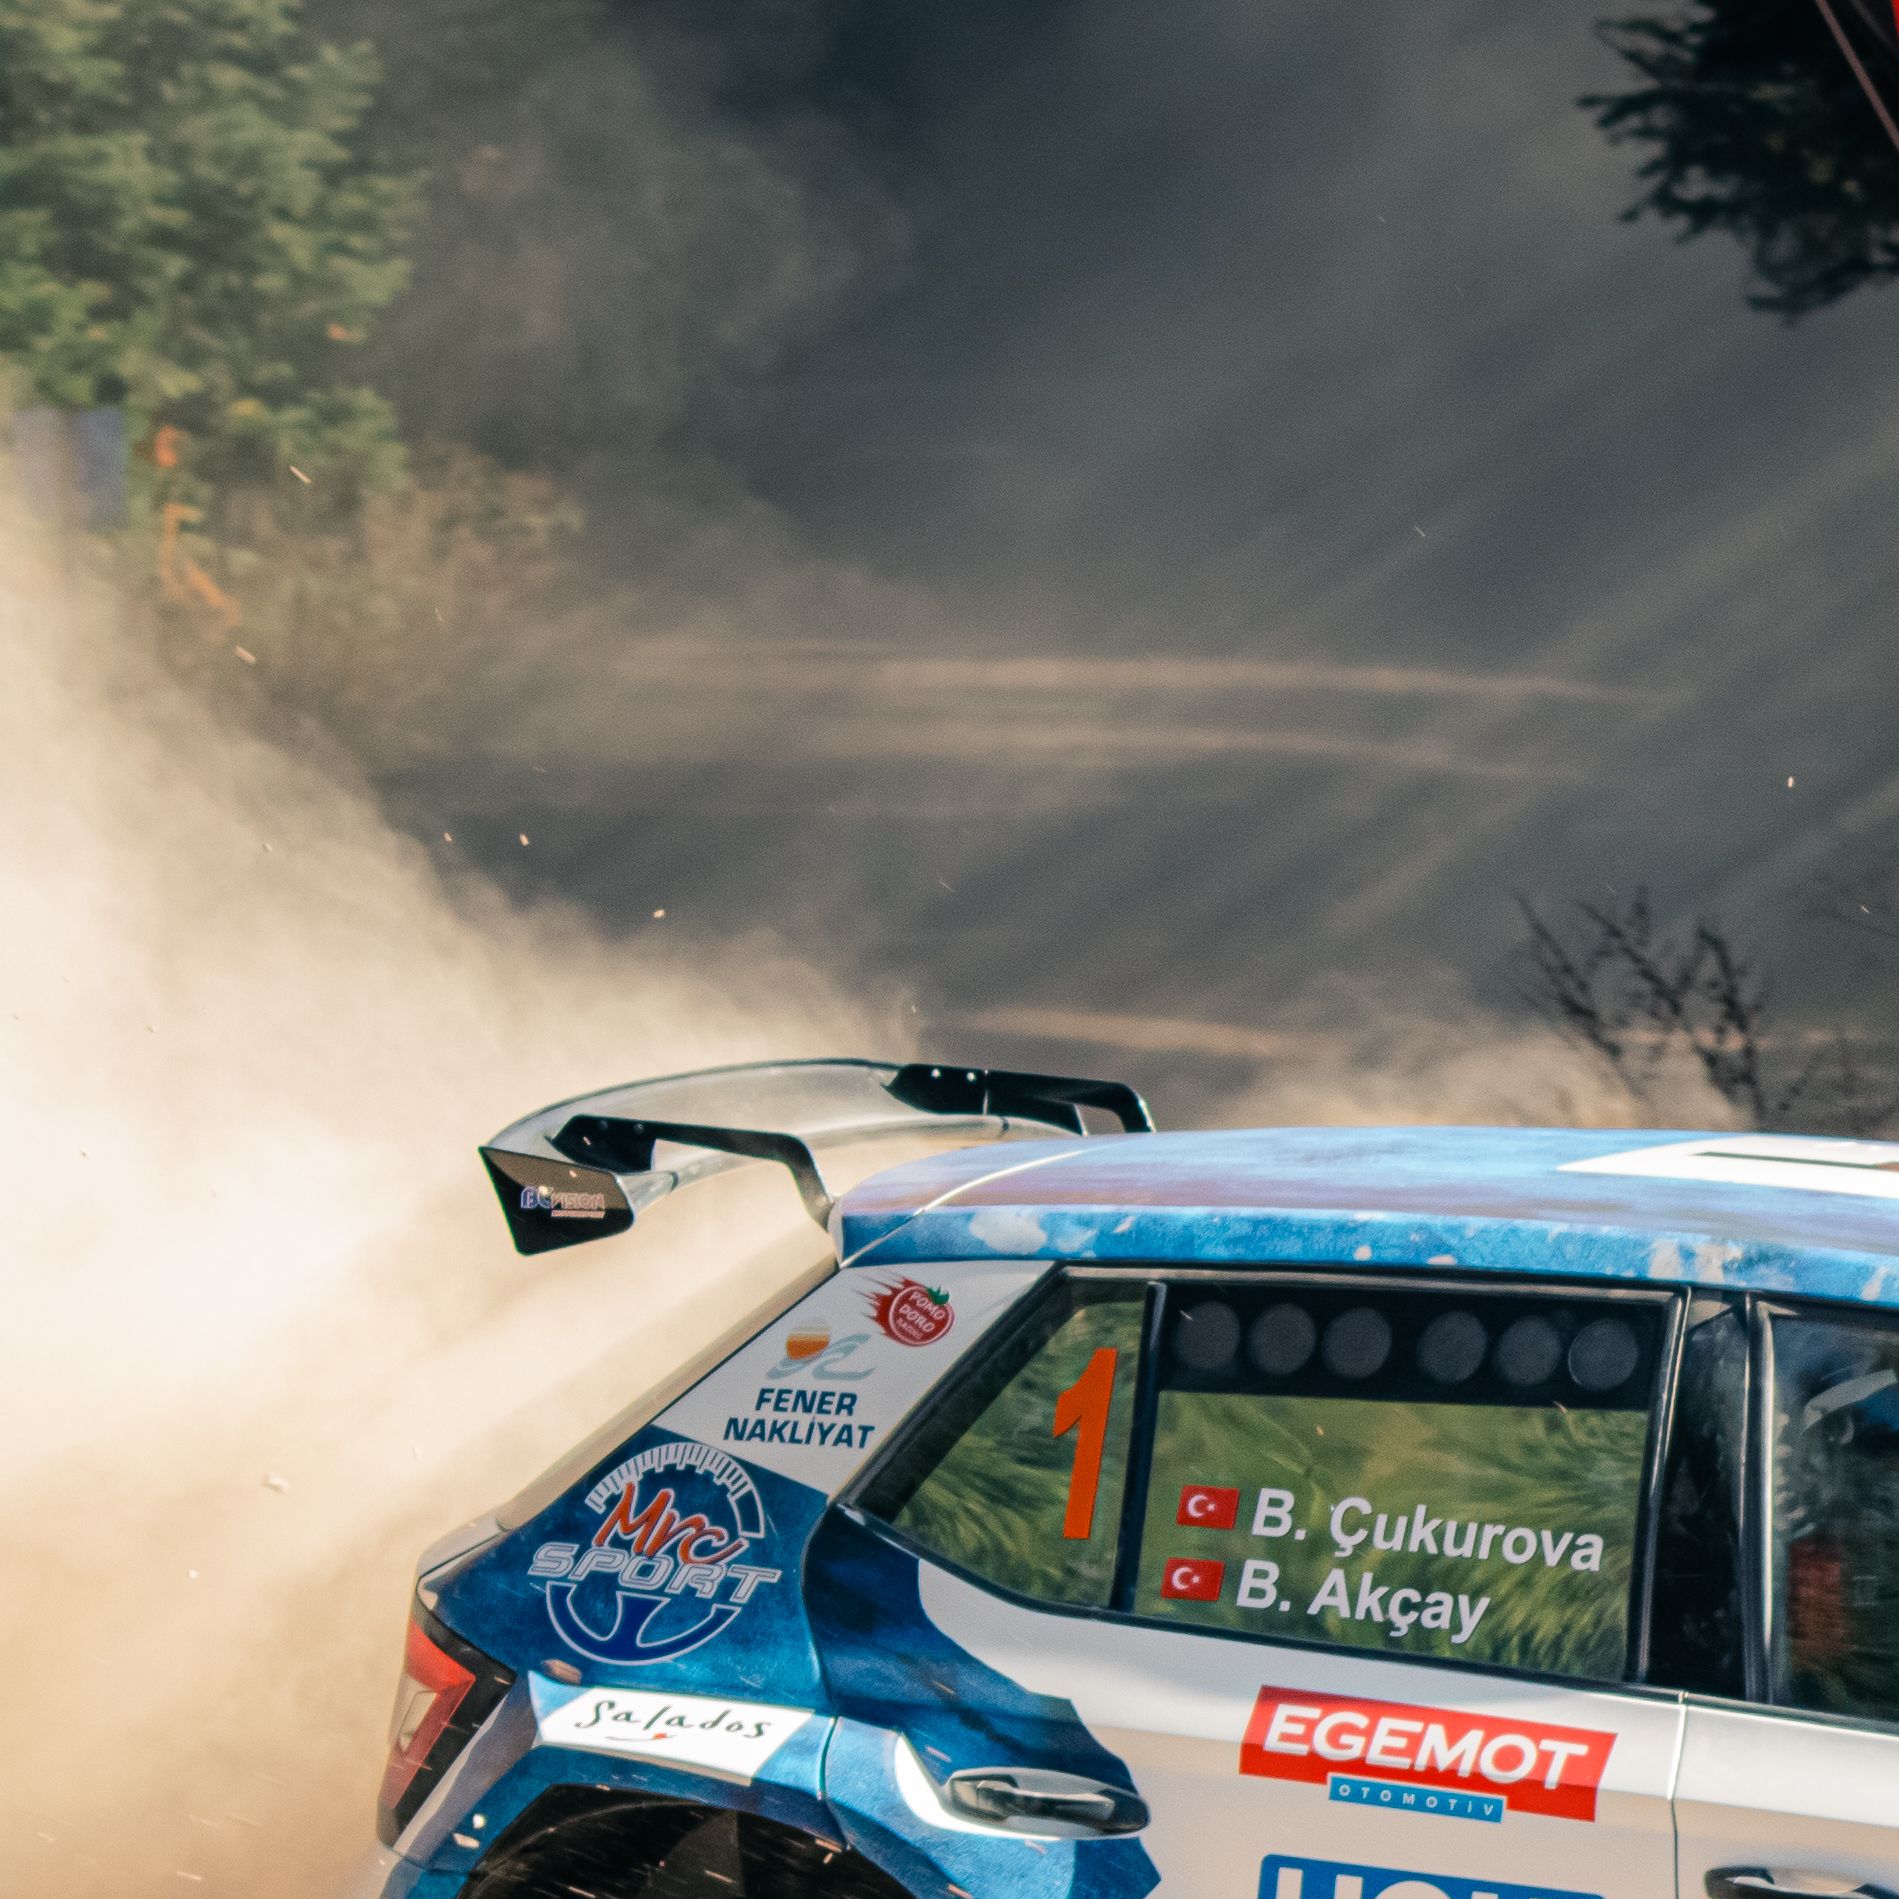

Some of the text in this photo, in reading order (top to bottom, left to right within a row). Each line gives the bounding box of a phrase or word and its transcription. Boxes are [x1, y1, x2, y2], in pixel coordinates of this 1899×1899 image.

[899, 1304, 935, 1332] DORO
[909, 1291, 946, 1320] POMO
[755, 1388, 858, 1417] FENER
[723, 1416, 876, 1449] NAKLİYAT
[1053, 1348, 1118, 1540] 1
[1252, 1487, 1604, 1572] B. Çukurova
[527, 1542, 782, 1604] SPORT
[1236, 1559, 1492, 1643] B. Akçay
[574, 1700, 773, 1739] Salados
[1263, 1705, 1588, 1790] EGEMOT
